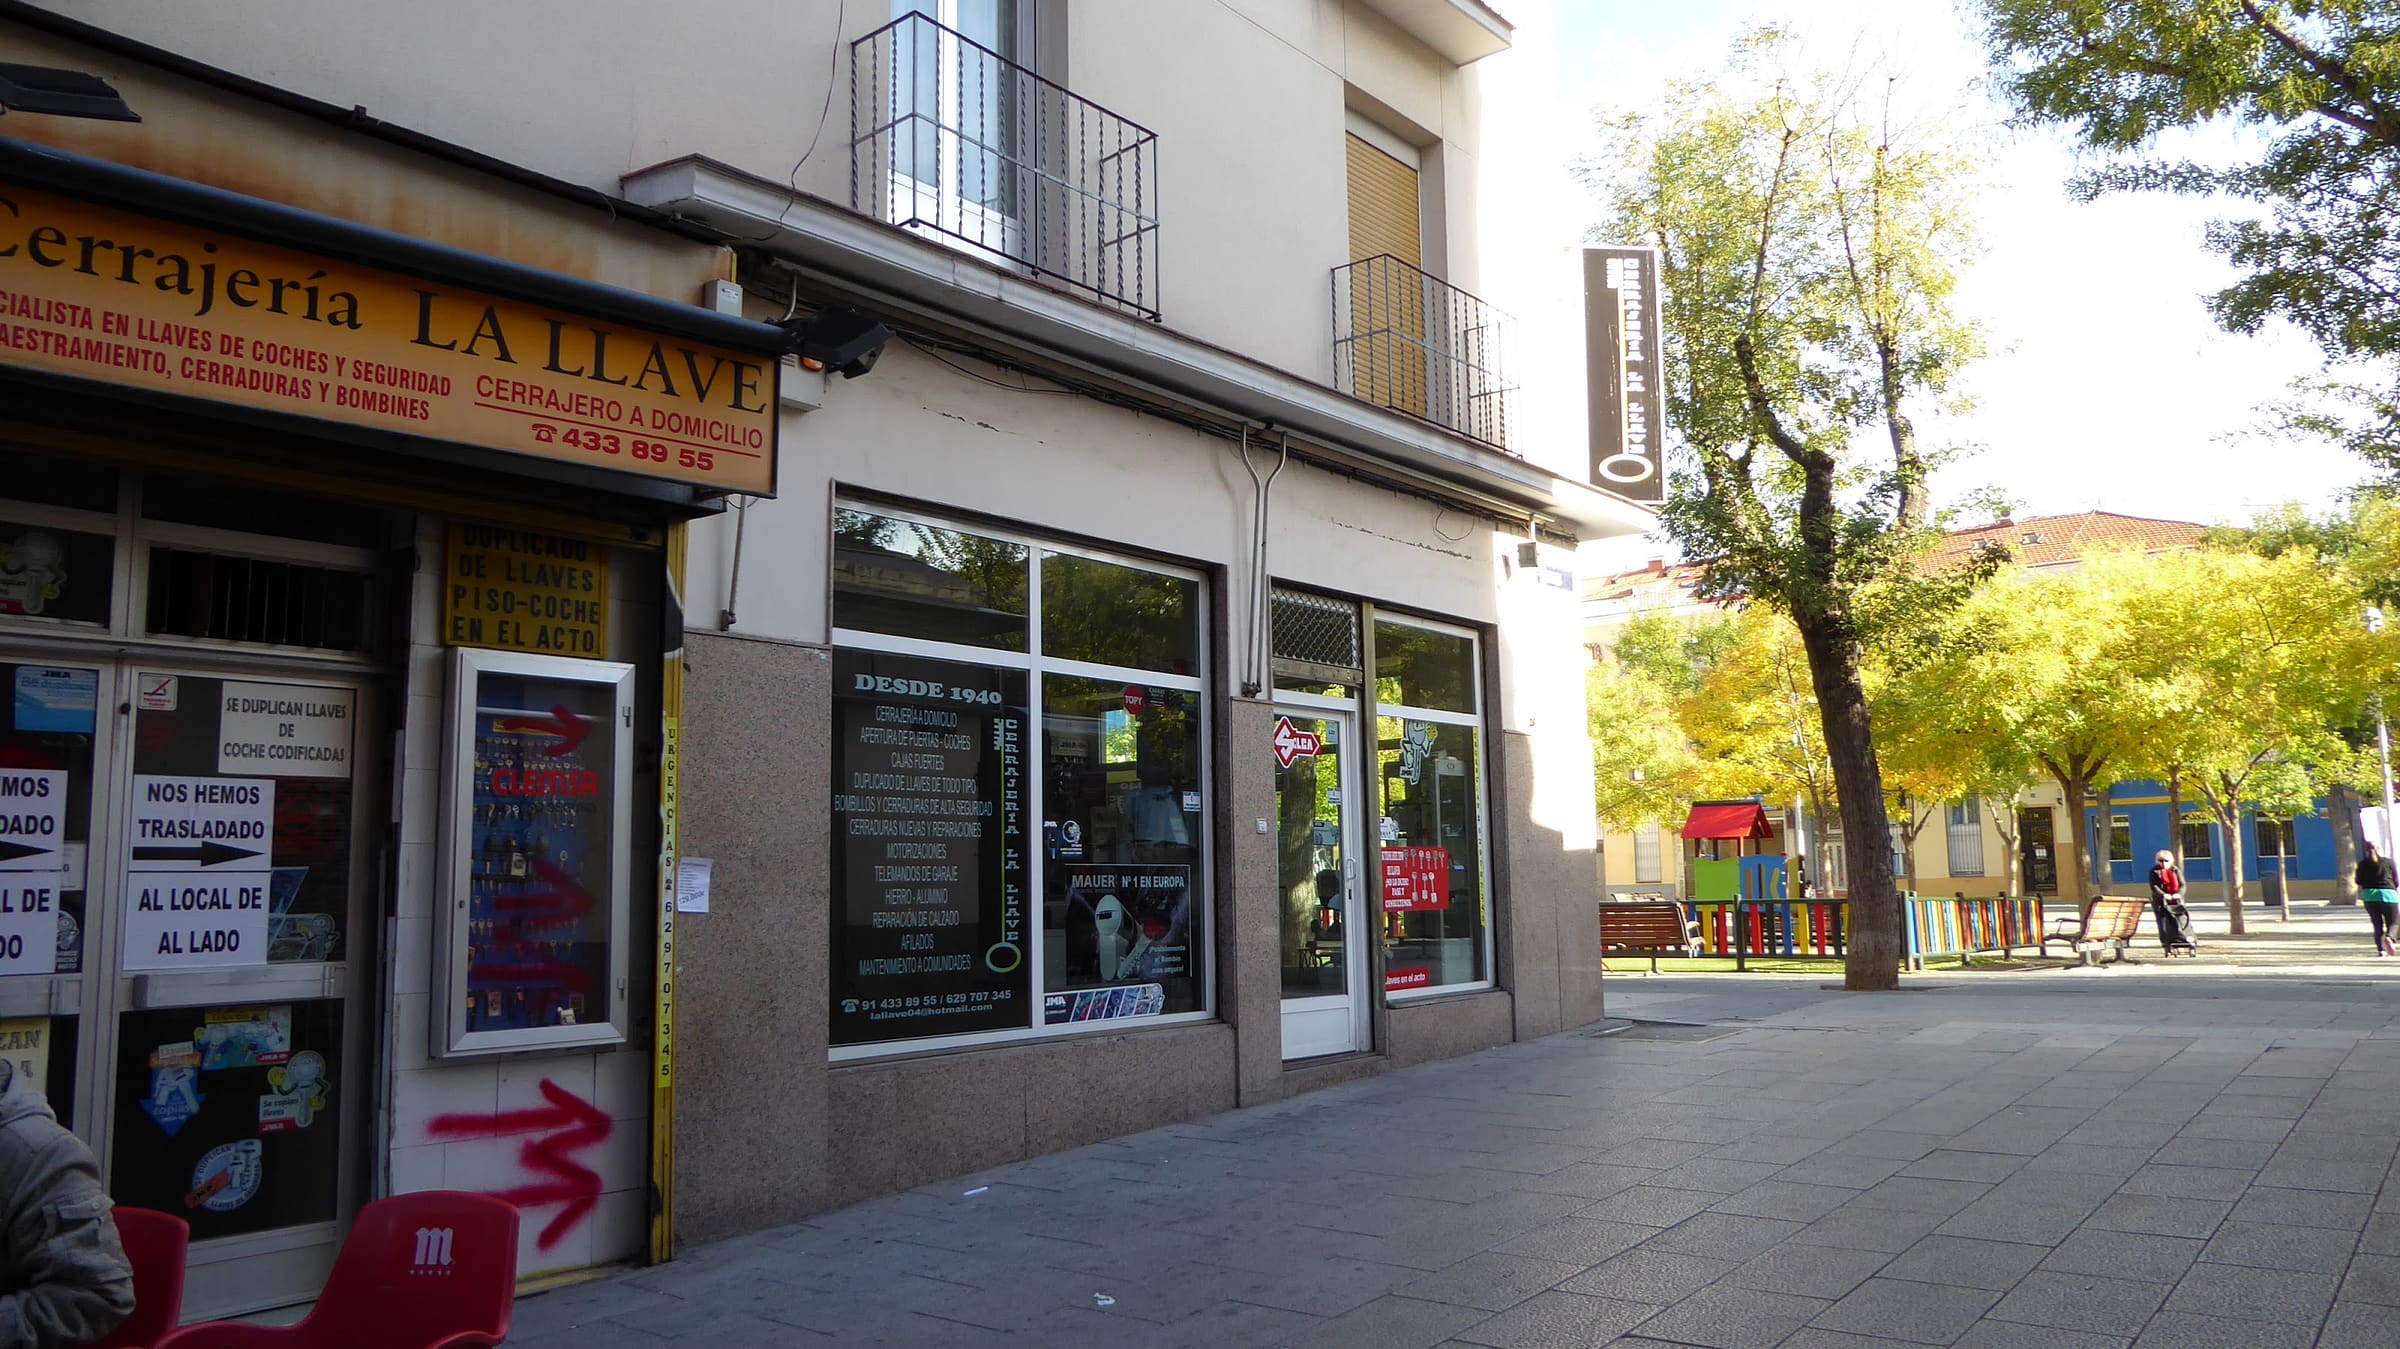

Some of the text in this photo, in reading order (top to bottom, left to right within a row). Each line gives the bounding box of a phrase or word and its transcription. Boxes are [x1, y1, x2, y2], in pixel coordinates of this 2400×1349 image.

[103, 311, 129, 337] EN
[138, 318, 212, 351] LLAVES
[220, 334, 244, 359] DE
[252, 340, 328, 374] COCHES
[336, 356, 346, 377] Y
[352, 360, 451, 396] SEGURIDAD
[411, 289, 517, 364] LA
[543, 319, 767, 414] LLAVE
[181, 356, 312, 400] CERRADURAS
[319, 381, 329, 402] Y
[337, 385, 430, 420] BOMBINES
[477, 375, 763, 449] CERRAJERO A DOMICILIO
[562, 428, 714, 471] 433 89 55
[459, 554, 593, 591] DE LLAVES
[454, 584, 601, 624] PISO-COCHE
[453, 616, 594, 652] EN EL ACTO
[854, 673, 1002, 704] DESDE 1940
[226, 697, 346, 719] SE DUPLICAN LLAVES
[1125, 695, 1143, 705] TOPY
[875, 705, 918, 726] CERRAJERÍA
[924, 710, 958, 728] DOMICILIO
[279, 723, 295, 738] DE
[860, 727, 897, 745] APERTURA
[898, 730, 908, 746] DE
[909, 730, 939, 748] PUERTAS
[944, 734, 971, 750] COCHES
[224, 743, 344, 762] COCHE CODIFICADAS
[891, 752, 944, 771] CAJAS FUERTES
[148, 783, 260, 805] NOS HEMOS
[492, 769, 599, 798] CLEMSA
[854, 772, 895, 791] DUPLICADO
[905, 775, 931, 792] LLAVES
[932, 777, 942, 792] DE
[942, 777, 961, 793] TODO
[961, 779, 977, 794] TIPO
[665, 729, 675, 866] URGENCIAS
[834, 794, 876, 812] BOMBILLOS
[883, 797, 929, 814] CERRADURAS
[930, 799, 940, 814] DE
[940, 800, 956, 815] ALTA
[956, 800, 992, 816] SEGURIDAD
[138, 819, 264, 839] TRASLADADO
[850, 818, 897, 836] CERRADURAS
[899, 819, 926, 836] NUEVAS
[932, 821, 982, 838] REPARACIONES
[1004, 718, 1020, 941] CERRAJERÍA LA LLAVE
[887, 843, 947, 859] MOTORIZACIONES
[873, 865, 958, 882] TELEMANDOS DE GARAJE
[1071, 874, 1115, 888] MAUER
[1140, 875, 1151, 888] EN
[1153, 875, 1185, 888] EUROPA
[22, 888, 50, 912] DE
[138, 888, 262, 911] AL LOCAL DE
[885, 888, 912, 904] HIERRO
[872, 908, 959, 928] REPARACIÓN DE CALZADO
[158, 930, 240, 954] AL LADO
[901, 933, 935, 950] AFILADOS
[859, 956, 916, 976] MANTENIMIENTO
[923, 954, 972, 973] COMUNIDADES
[861, 1000, 876, 1011] 91
[880, 998, 902, 1009] 433
[905, 996, 920, 1007] 89
[923, 995, 938, 1006] 55
[947, 992, 966, 1004] 629
[969, 991, 989, 1002] 707
[991, 990, 1012, 1001] 345
